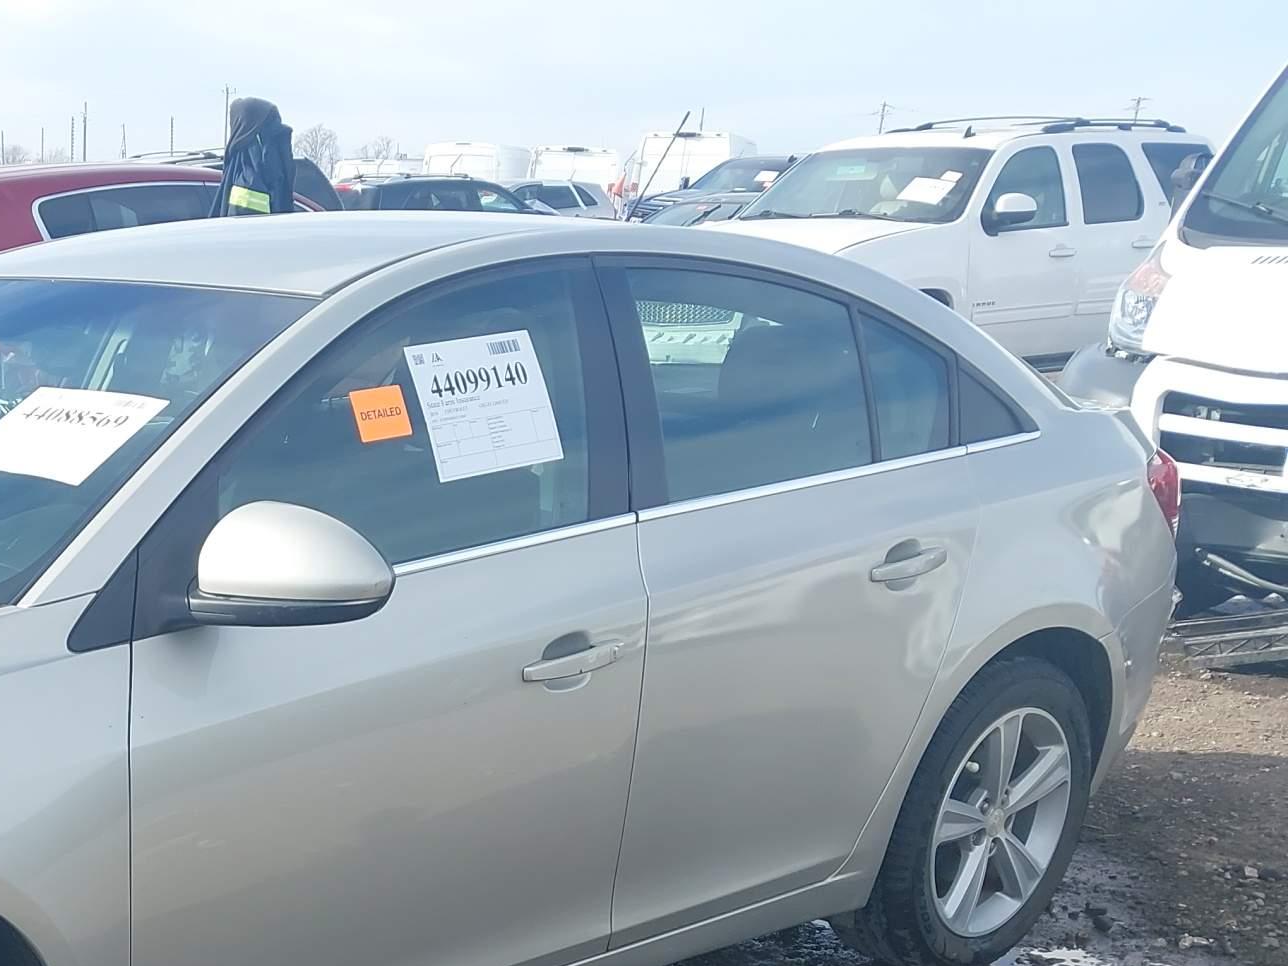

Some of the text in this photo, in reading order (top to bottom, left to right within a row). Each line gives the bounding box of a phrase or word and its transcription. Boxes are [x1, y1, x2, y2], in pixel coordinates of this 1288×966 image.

[430, 361, 528, 398] 44099140
[23, 406, 129, 428] 44088569
[360, 406, 402, 421] DETAILED
